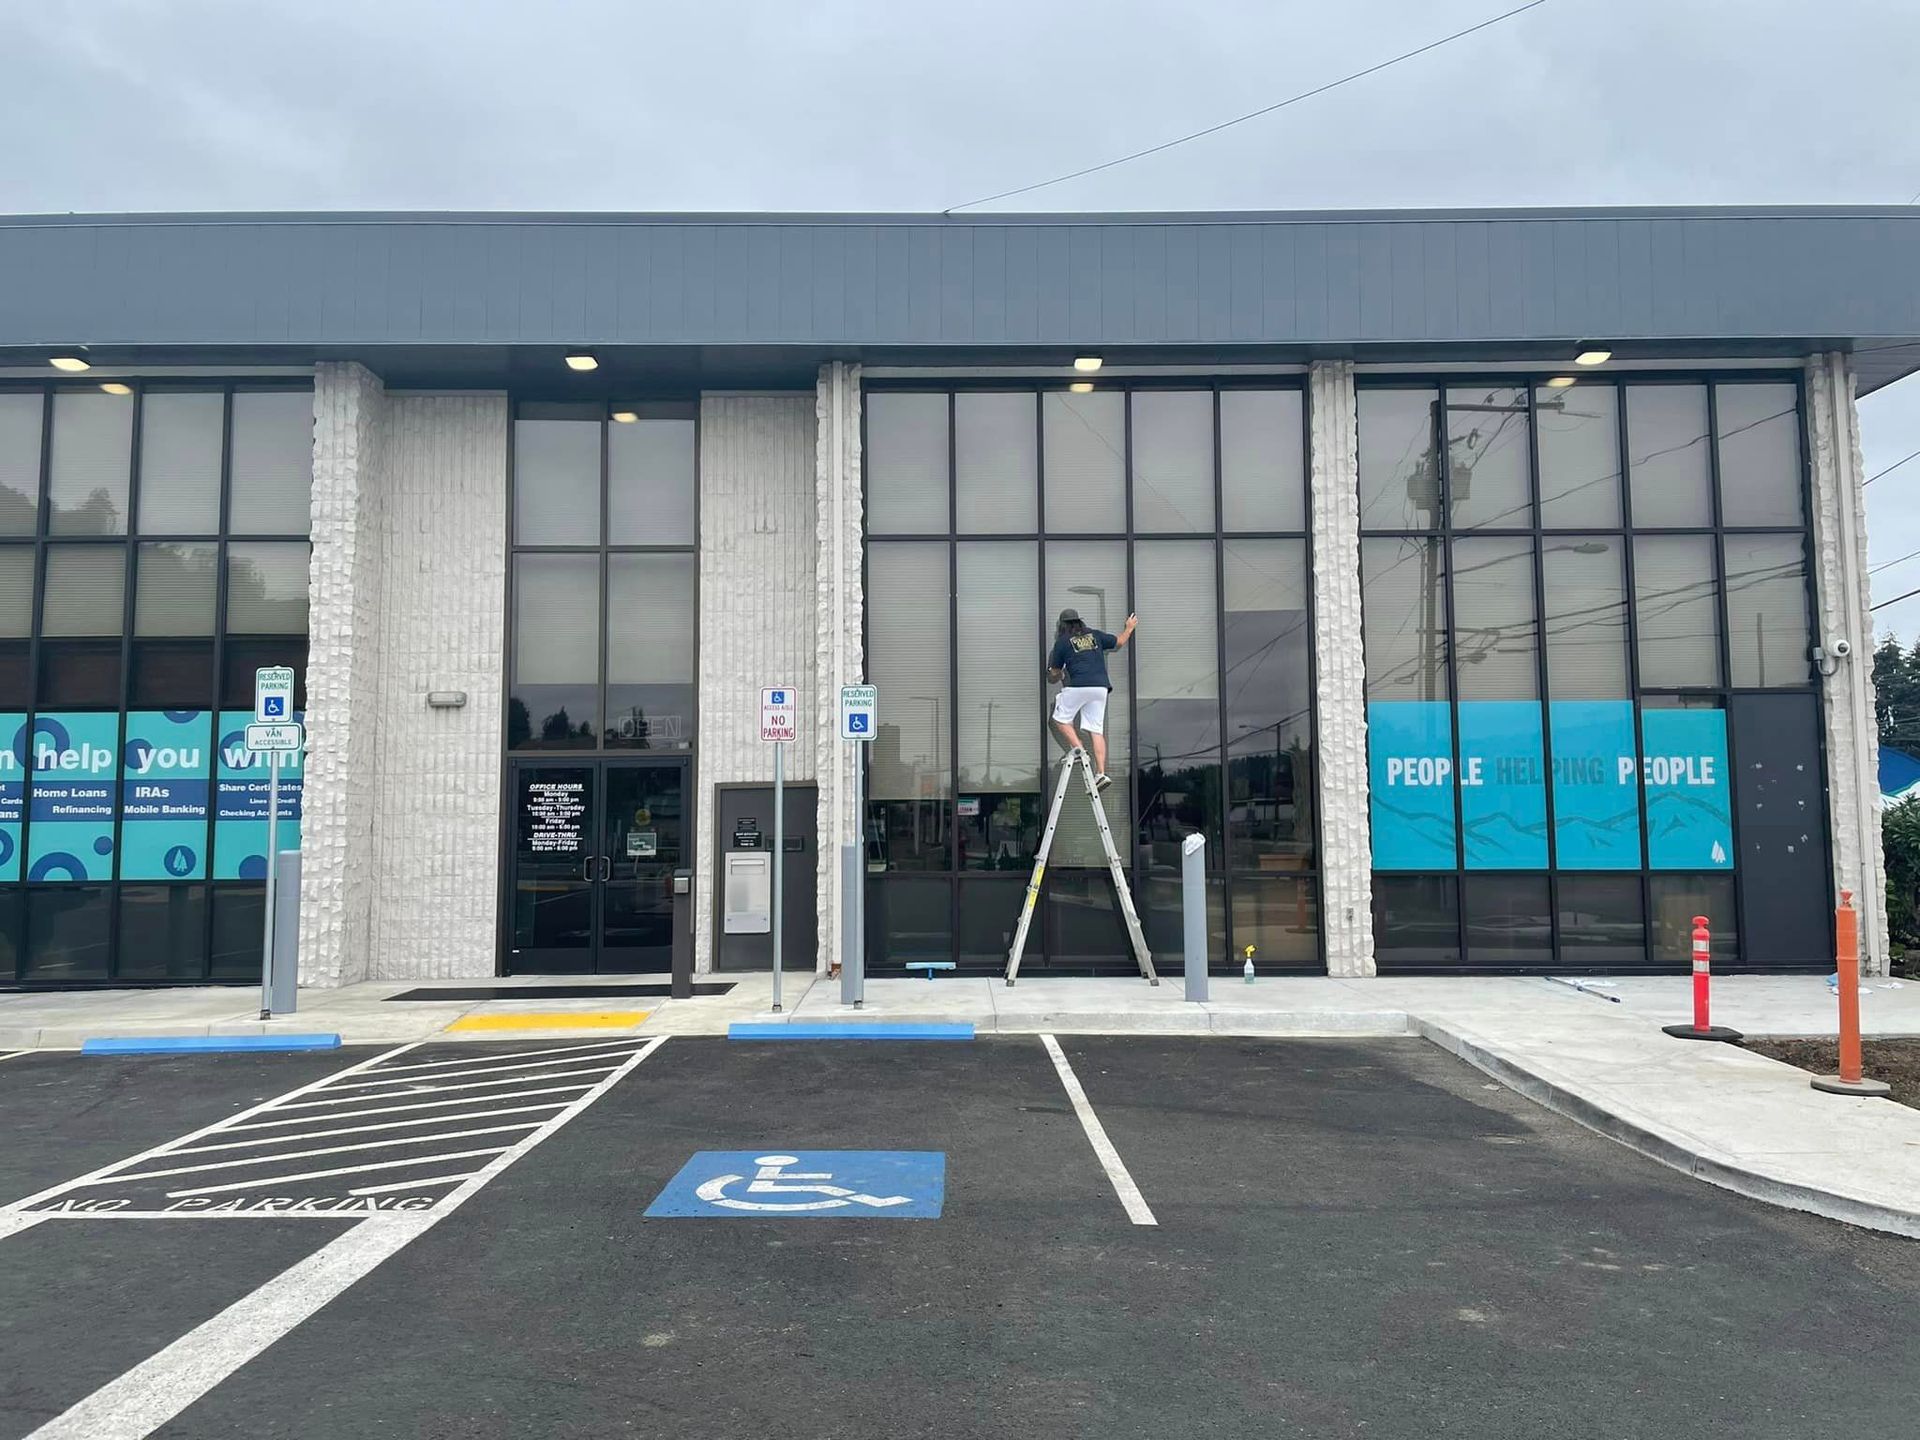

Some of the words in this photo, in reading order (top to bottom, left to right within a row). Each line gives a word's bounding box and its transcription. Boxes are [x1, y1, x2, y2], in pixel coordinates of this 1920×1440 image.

[259, 672, 291, 680] RESERVED
[261, 682, 289, 690] PARKING
[843, 690, 874, 698] RESERVED
[845, 699, 873, 707] PARKING
[771, 715, 786, 726] NO
[763, 728, 794, 738] PARKING
[38, 743, 112, 773] help
[137, 748, 200, 774] you
[1387, 757, 1483, 786] PEOPLE
[1618, 757, 1715, 785] PEOPLE
[135, 786, 170, 798] IRAs
[219, 784, 246, 792] Share
[248, 783, 302, 792] Certicates
[33, 788, 68, 798] Home
[71, 788, 107, 798] Loans
[0, 811, 19, 819] ans
[52, 805, 112, 815] Refinancing
[124, 805, 159, 814] Mobile
[162, 805, 206, 815] Banking
[219, 809, 256, 818] Checking
[50, 1198, 132, 1212] NO
[163, 1197, 433, 1213] PARKING
